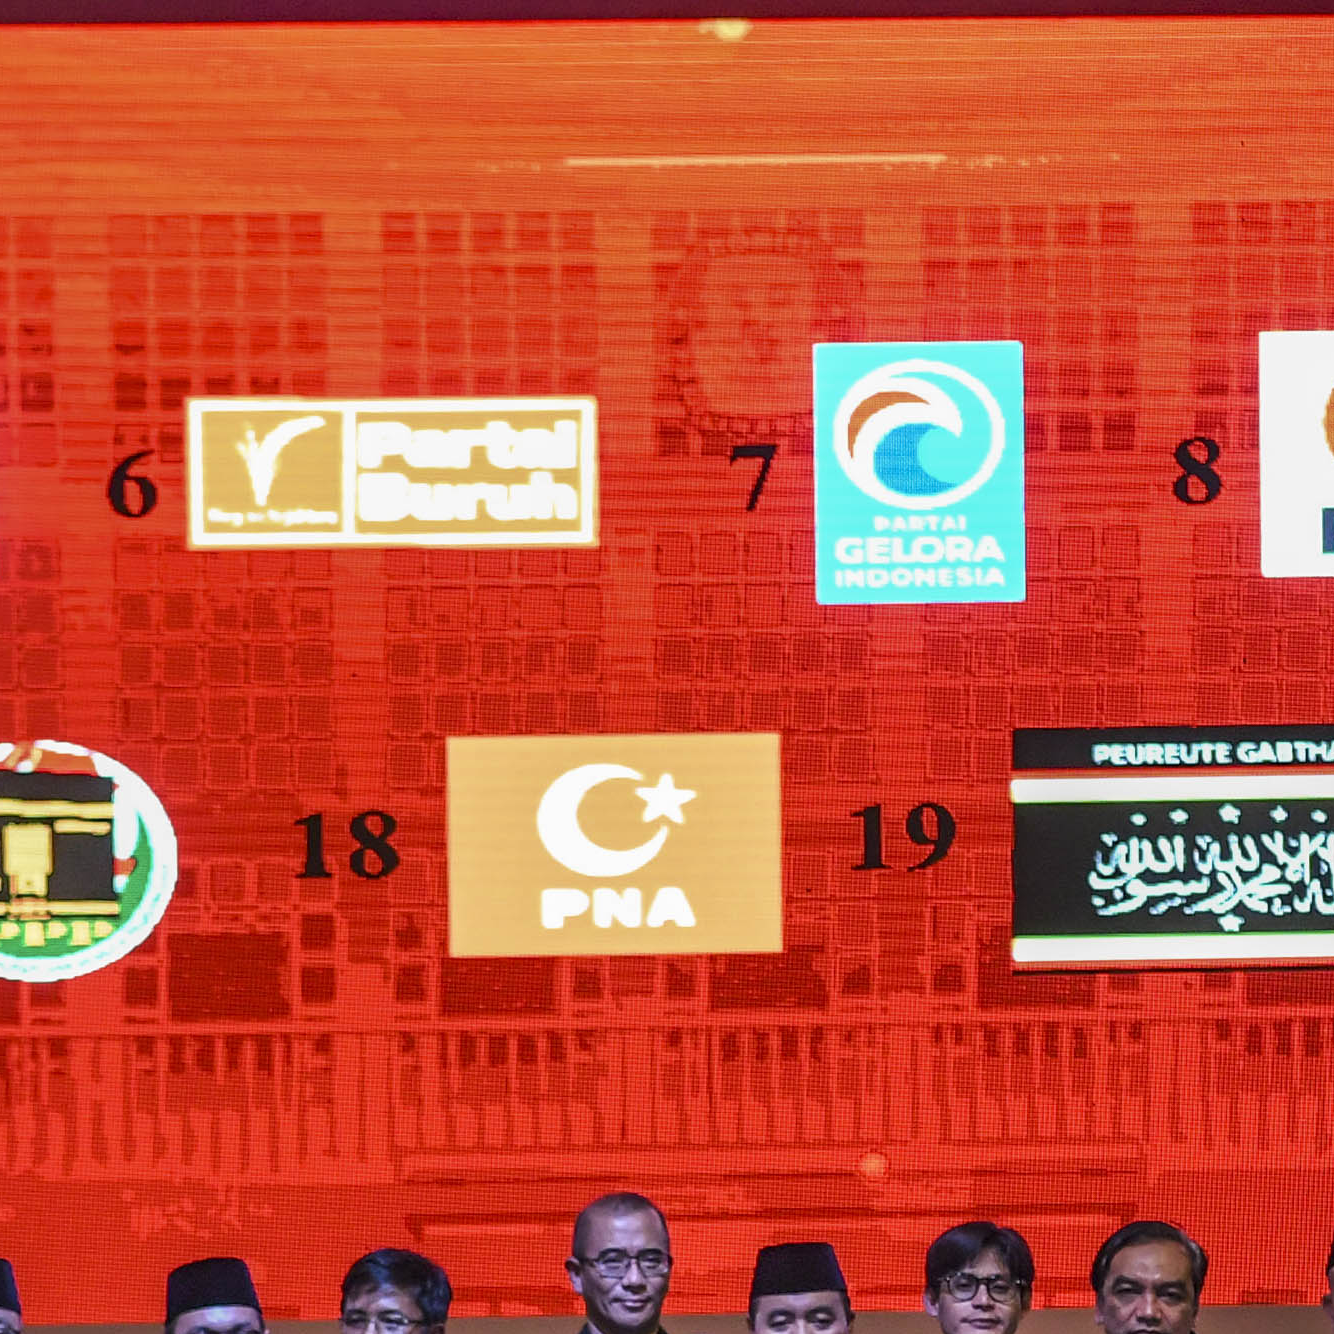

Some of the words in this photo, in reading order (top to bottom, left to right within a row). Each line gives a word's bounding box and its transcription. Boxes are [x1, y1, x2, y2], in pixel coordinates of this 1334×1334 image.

[107, 449, 157, 518] 6
[729, 444, 779, 511] 7
[1173, 436, 1223, 504] 8
[833, 535, 1006, 565] GELORA
[873, 515, 966, 532] PARTAI
[833, 567, 1006, 588] INDONESIA
[1092, 742, 1233, 765] PEUREUTE
[294, 809, 400, 879] 18
[851, 802, 956, 873] 19
[540, 886, 697, 930] PNA
